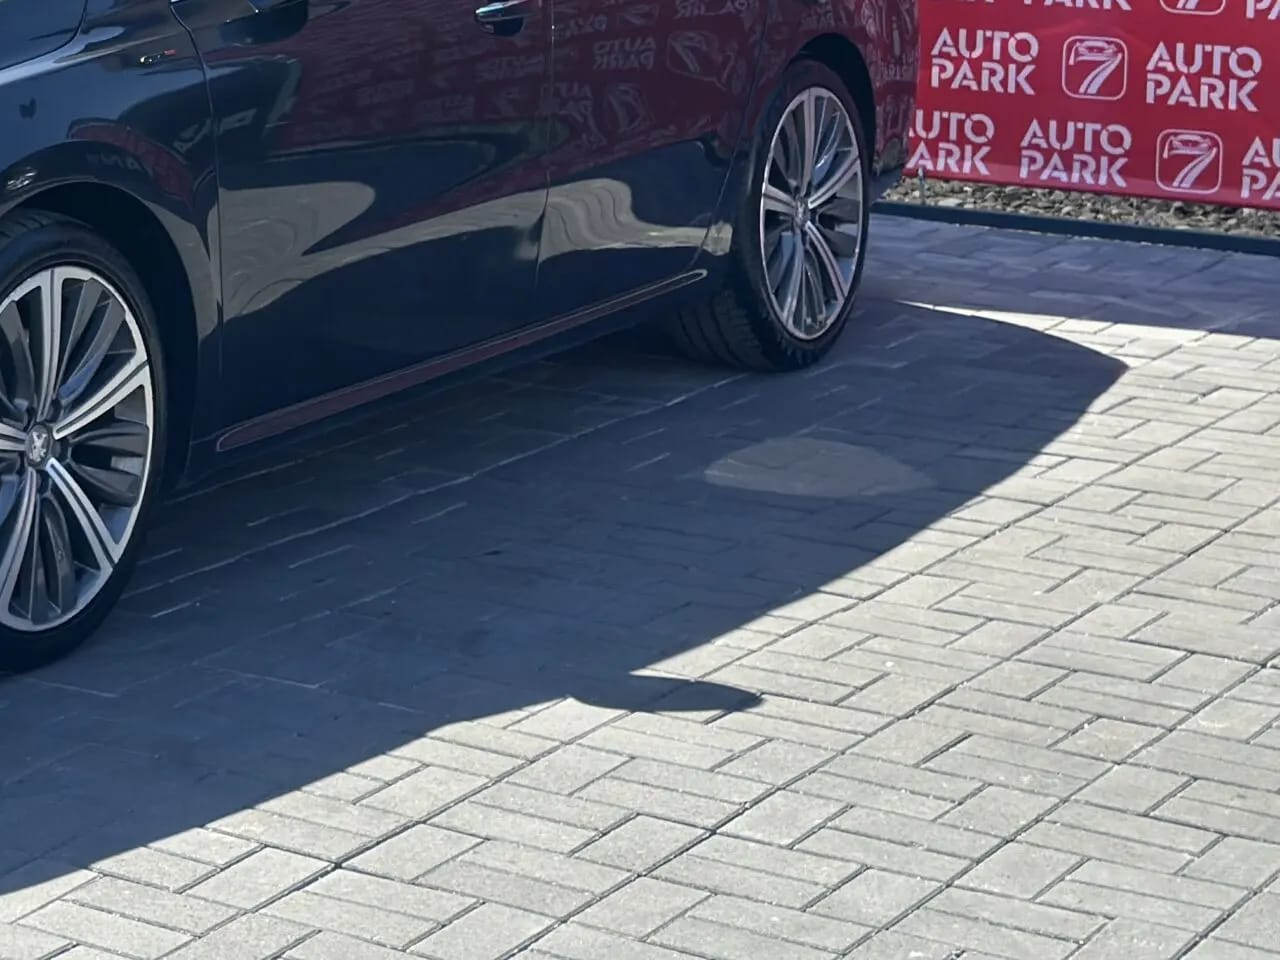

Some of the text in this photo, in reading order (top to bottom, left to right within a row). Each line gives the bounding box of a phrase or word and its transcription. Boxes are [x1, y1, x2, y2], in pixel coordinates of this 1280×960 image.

[931, 27, 1039, 62] AUTO
[1146, 41, 1262, 78] AUTO
[931, 58, 1036, 95] PARK
[1146, 73, 1258, 112] PARK
[1021, 119, 1132, 154] AUTO
[908, 141, 990, 177] ARK
[1020, 150, 1128, 187] PARK
